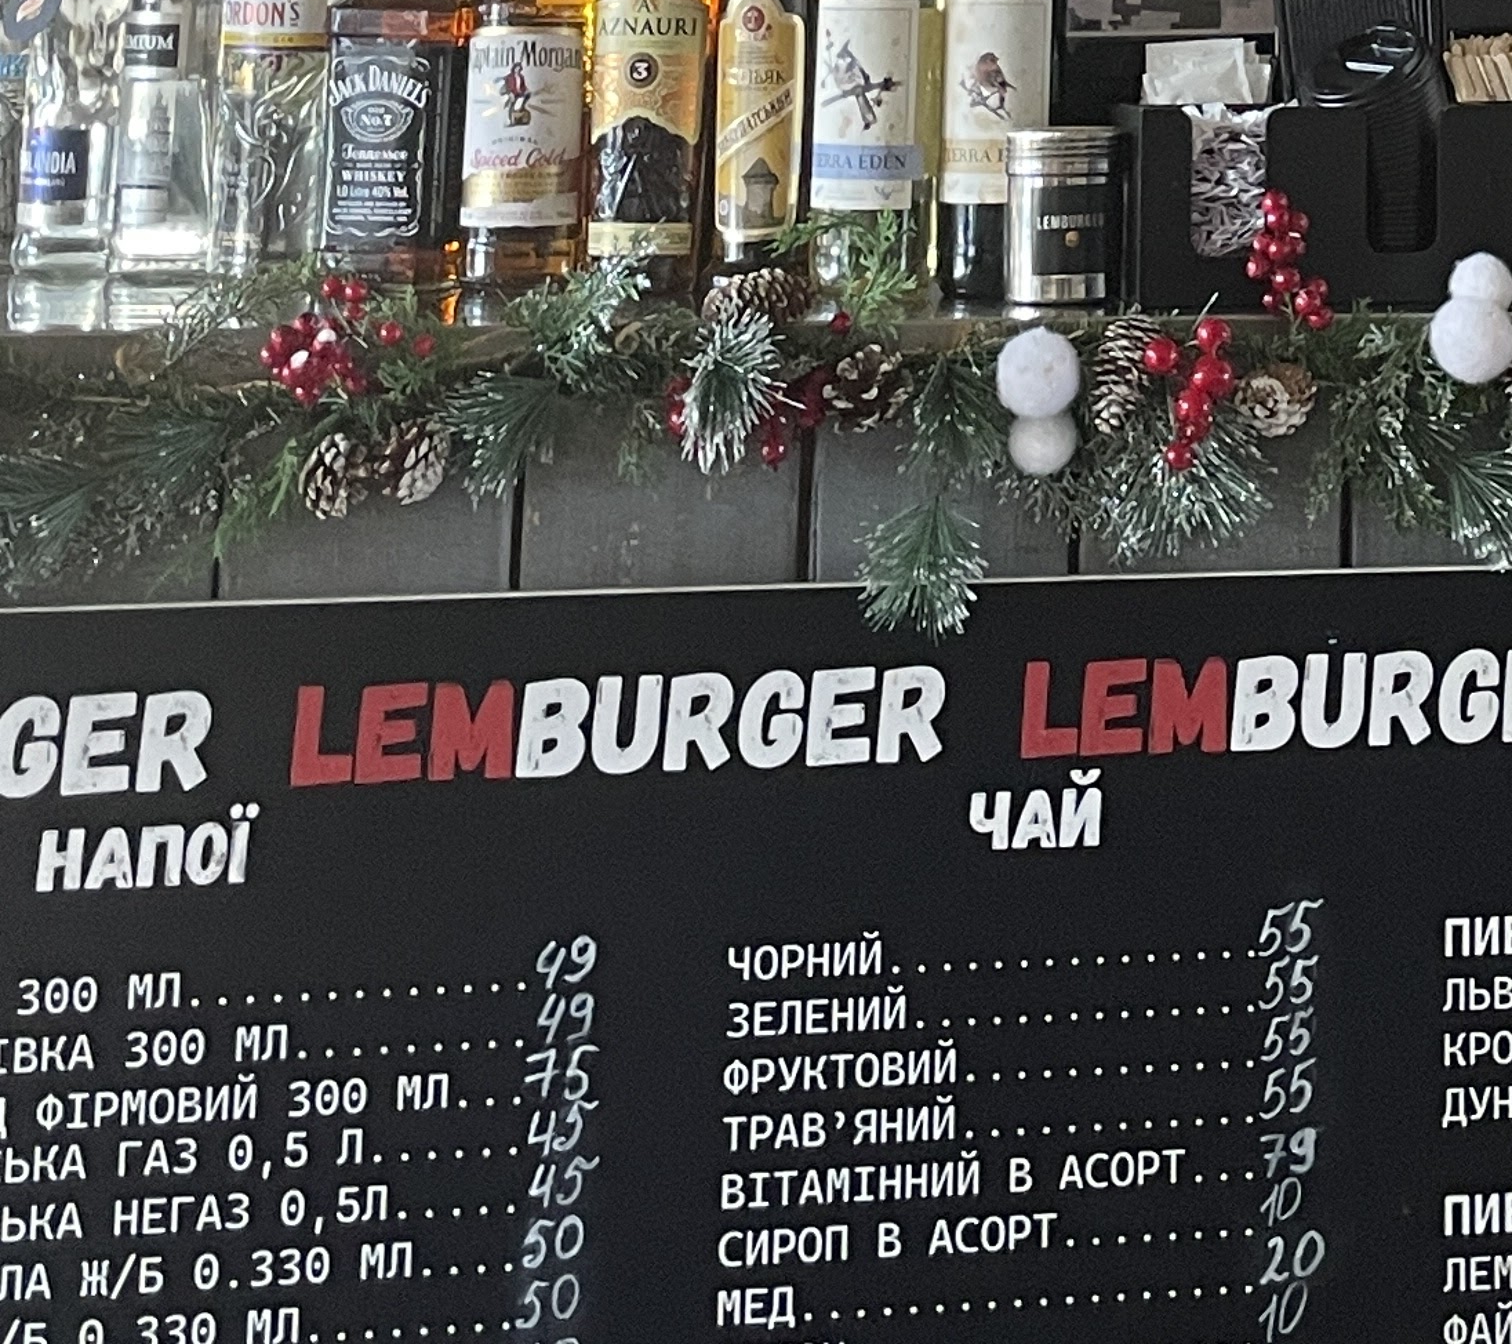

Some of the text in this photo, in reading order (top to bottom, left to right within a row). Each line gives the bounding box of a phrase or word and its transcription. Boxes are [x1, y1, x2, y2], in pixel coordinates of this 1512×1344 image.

[328, 64, 433, 109] JACK DANIEL'S
[341, 170, 407, 183] WHISKEY
[0, 691, 211, 798] GER
[290, 664, 946, 788] LEMBURGER
[36, 803, 259, 892] НАПОЇ
[970, 769, 1102, 850] ЧАЙ
[17, 935, 596, 1015] 300 МЛ 49
[728, 899, 1323, 980] ЧОРНИЙ 55
[125, 993, 594, 1068] 300 МЛ 49
[727, 955, 1319, 1038] ЗЕЛЕНИЙ 55
[37, 1073, 257, 1131] ФІРМОВИЙ
[288, 1078, 367, 1117] 300
[397, 1073, 448, 1111] МЛ
[524, 1045, 599, 1100] 75
[724, 1006, 1313, 1095] ФРУКТОВИЙ 55
[1259, 1058, 1316, 1119] 55
[118, 1100, 599, 1180] ГАЗ 0,5 Л 45
[721, 1127, 1318, 1210] ВІТАМІННИЙ В АСОРТ 79
[114, 1193, 249, 1236] НЕГАЗ
[281, 1185, 387, 1234] 0,5Л
[528, 1156, 599, 1208] 45
[718, 1177, 1301, 1267] СИРОП В АСОРТ 10
[80, 1253, 163, 1300] Ж/Б
[194, 1247, 329, 1290] 0.330
[360, 1242, 412, 1280] МЛ
[522, 1215, 584, 1268] 50
[717, 1230, 1324, 1330] МЕД 20
[246, 1274, 579, 1344] МЛ 50
[1259, 1282, 1307, 1343] 10
